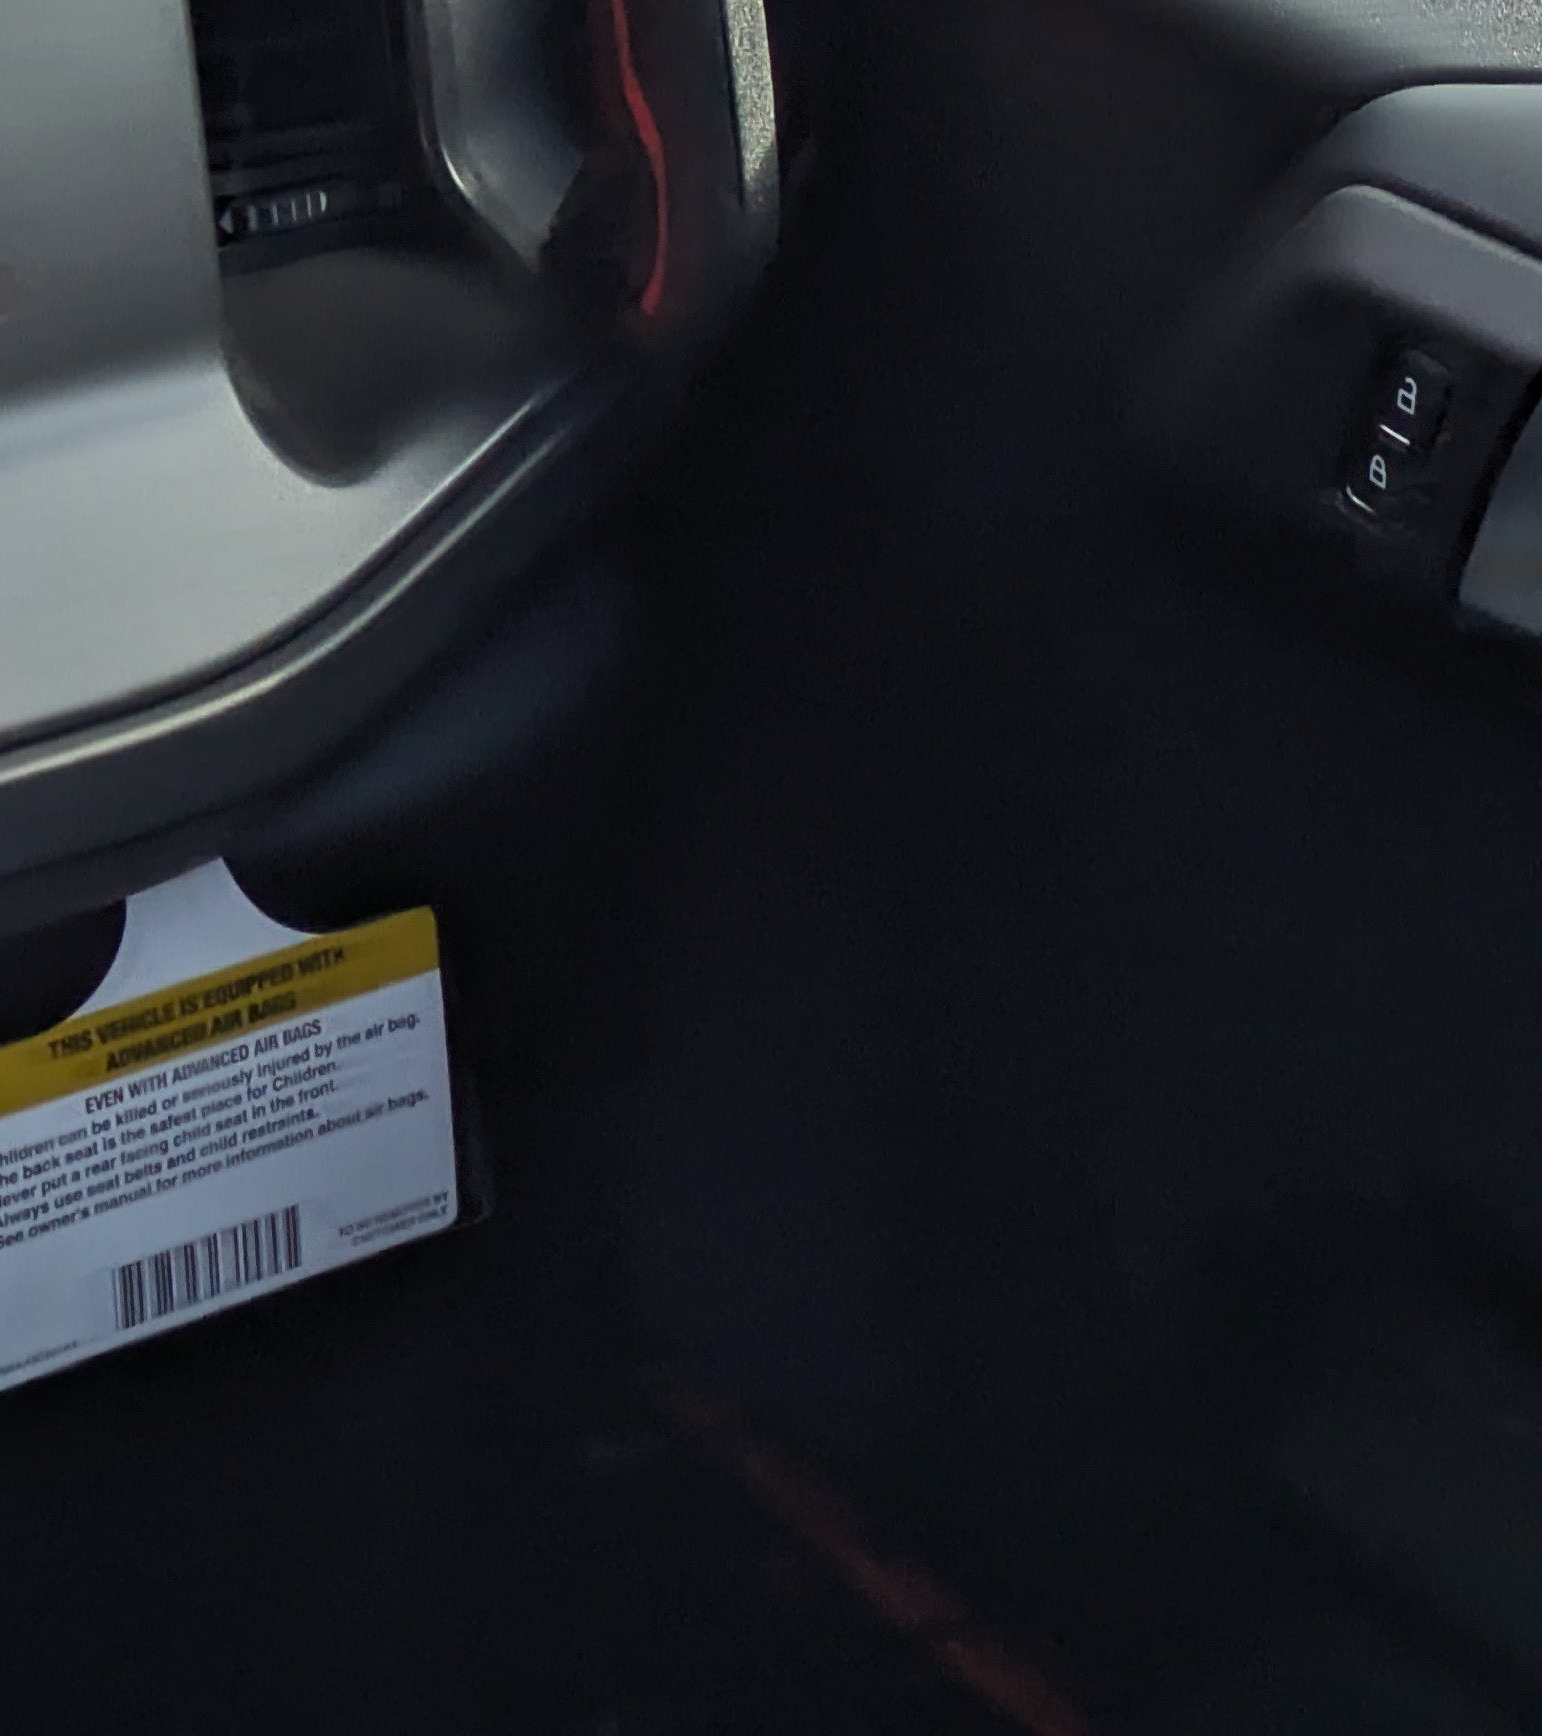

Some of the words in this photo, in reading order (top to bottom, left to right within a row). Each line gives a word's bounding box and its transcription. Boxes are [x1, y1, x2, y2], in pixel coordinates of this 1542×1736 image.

[49, 1028, 92, 1061] THIS
[98, 1000, 176, 1045] VEHICLE
[179, 993, 199, 1018] IS
[203, 961, 294, 1009] EQUIPPED
[297, 944, 345, 978] WITH
[106, 1020, 207, 1072] ADVANCED
[210, 1008, 243, 1037] AIR
[247, 990, 296, 1024] BAGS
[22, 1153, 60, 1180] back
[64, 1140, 98, 1165] seat
[120, 1124, 145, 1146] the
[150, 1106, 197, 1136] safest
[200, 1091, 243, 1120] place
[246, 1080, 268, 1102] for
[271, 1056, 338, 1093] Children.
[58, 1126, 87, 1147] can
[90, 1115, 111, 1135] be
[115, 1099, 157, 1127] killed
[161, 1095, 178, 1111] or
[181, 1067, 253, 1108] seriously
[314, 1038, 333, 1061] by
[336, 1029, 360, 1050] the
[363, 1020, 385, 1040] air
[388, 1009, 420, 1036] bag.
[84, 1086, 124, 1115] EVEN
[127, 1070, 167, 1100] WITH
[171, 1043, 250, 1084] ADVANCED
[253, 1033, 278, 1056] AIR
[282, 1017, 321, 1047] BAGS
[27, 1203, 90, 1239] owner's
[92, 1181, 152, 1215] manual
[155, 1172, 178, 1193] for
[181, 1158, 222, 1183] more
[226, 1124, 313, 1168] information
[317, 1107, 361, 1136] about
[364, 1099, 385, 1120] air
[386, 1083, 428, 1115] bags.
[40, 1172, 67, 1197] put
[84, 1155, 117, 1178] rear
[120, 1136, 169, 1169] facing
[172, 1122, 211, 1148] child
[215, 1109, 248, 1133] seat
[269, 1091, 294, 1113] the
[298, 1076, 338, 1104] front.
[53, 1188, 83, 1210] use
[86, 1174, 120, 1198] seat
[123, 1159, 162, 1185] belts
[166, 1146, 196, 1170] and
[199, 1132, 237, 1158] child
[241, 1103, 319, 1143] restraints.
